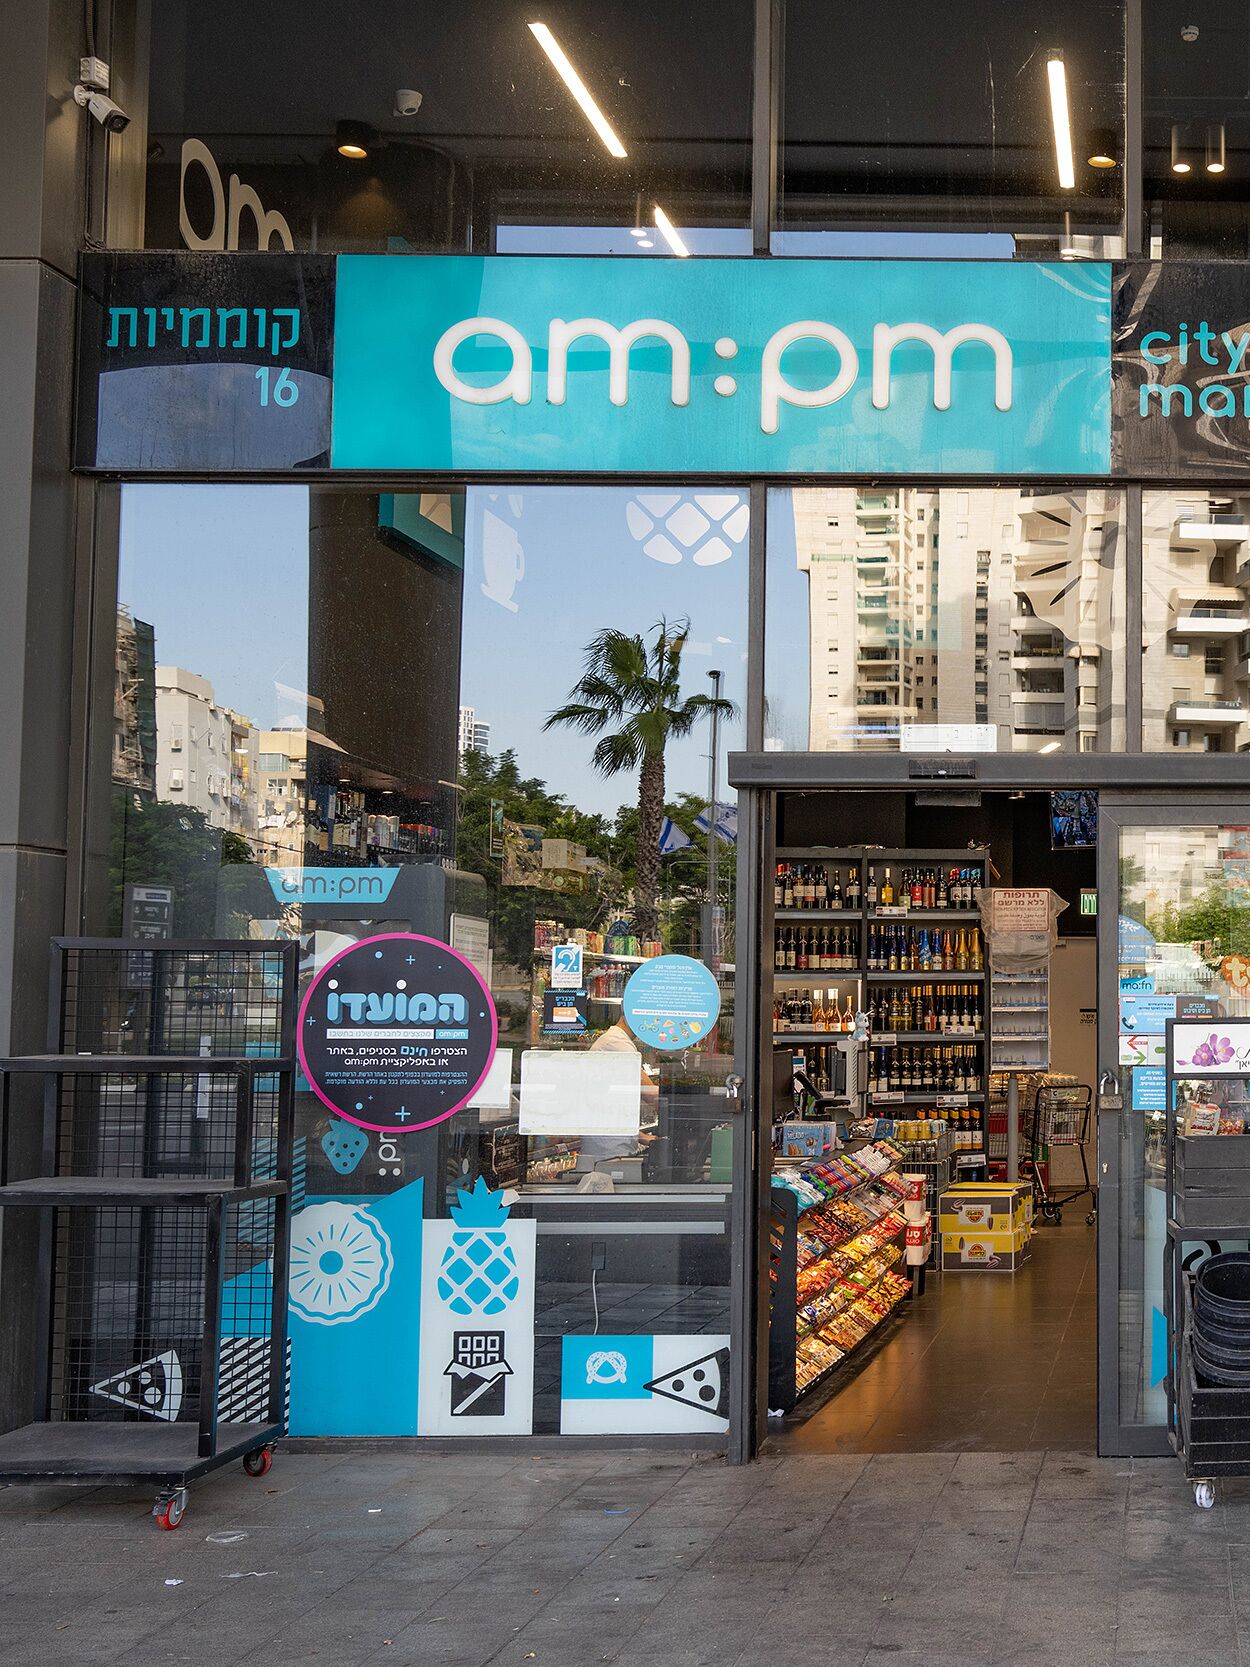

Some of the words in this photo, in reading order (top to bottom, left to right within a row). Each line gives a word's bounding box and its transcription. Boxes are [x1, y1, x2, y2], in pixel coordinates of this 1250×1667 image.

[105, 307, 300, 356] קוממיות
[1139, 321, 1250, 374] city
[434, 317, 1013, 435] am:pm
[255, 367, 299, 407] 16
[282, 877, 383, 898] am:pm
[327, 979, 469, 1024] המועדו
[355, 1030, 372, 1038] שלנו
[374, 1030, 402, 1038] לחברים
[439, 1031, 466, 1039] am:pm
[326, 1047, 354, 1055] באתר
[356, 1047, 397, 1056] בסניפים,
[400, 1046, 428, 1056] חינם
[431, 1047, 467, 1055] הצטרפו
[344, 1058, 379, 1067] am:pm
[380, 1057, 436, 1067] באפליקציית
[439, 1058, 449, 1066] או
